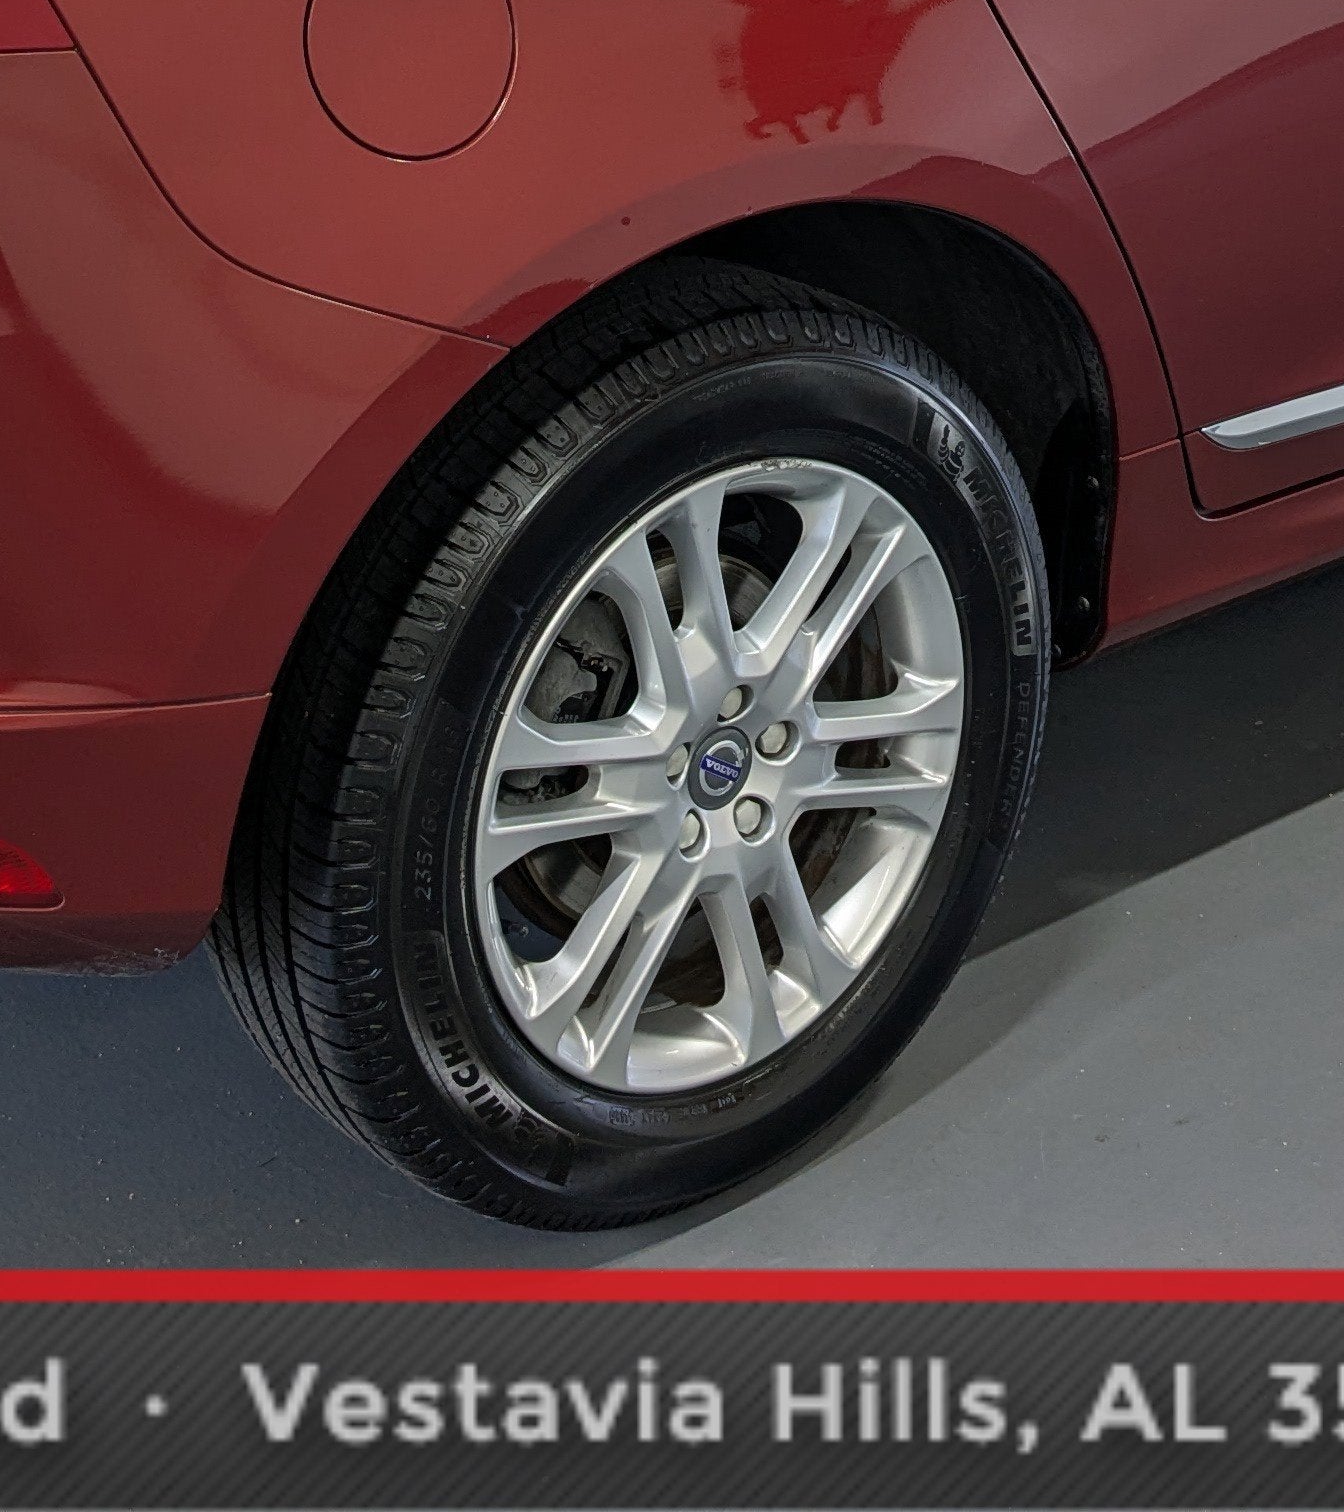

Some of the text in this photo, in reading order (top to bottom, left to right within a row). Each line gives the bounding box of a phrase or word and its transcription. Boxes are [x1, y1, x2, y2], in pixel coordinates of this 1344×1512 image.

[964, 467, 1033, 647] MICHELIN
[705, 757, 739, 779] VOLVO
[416, 940, 514, 1128] MICHELIN
